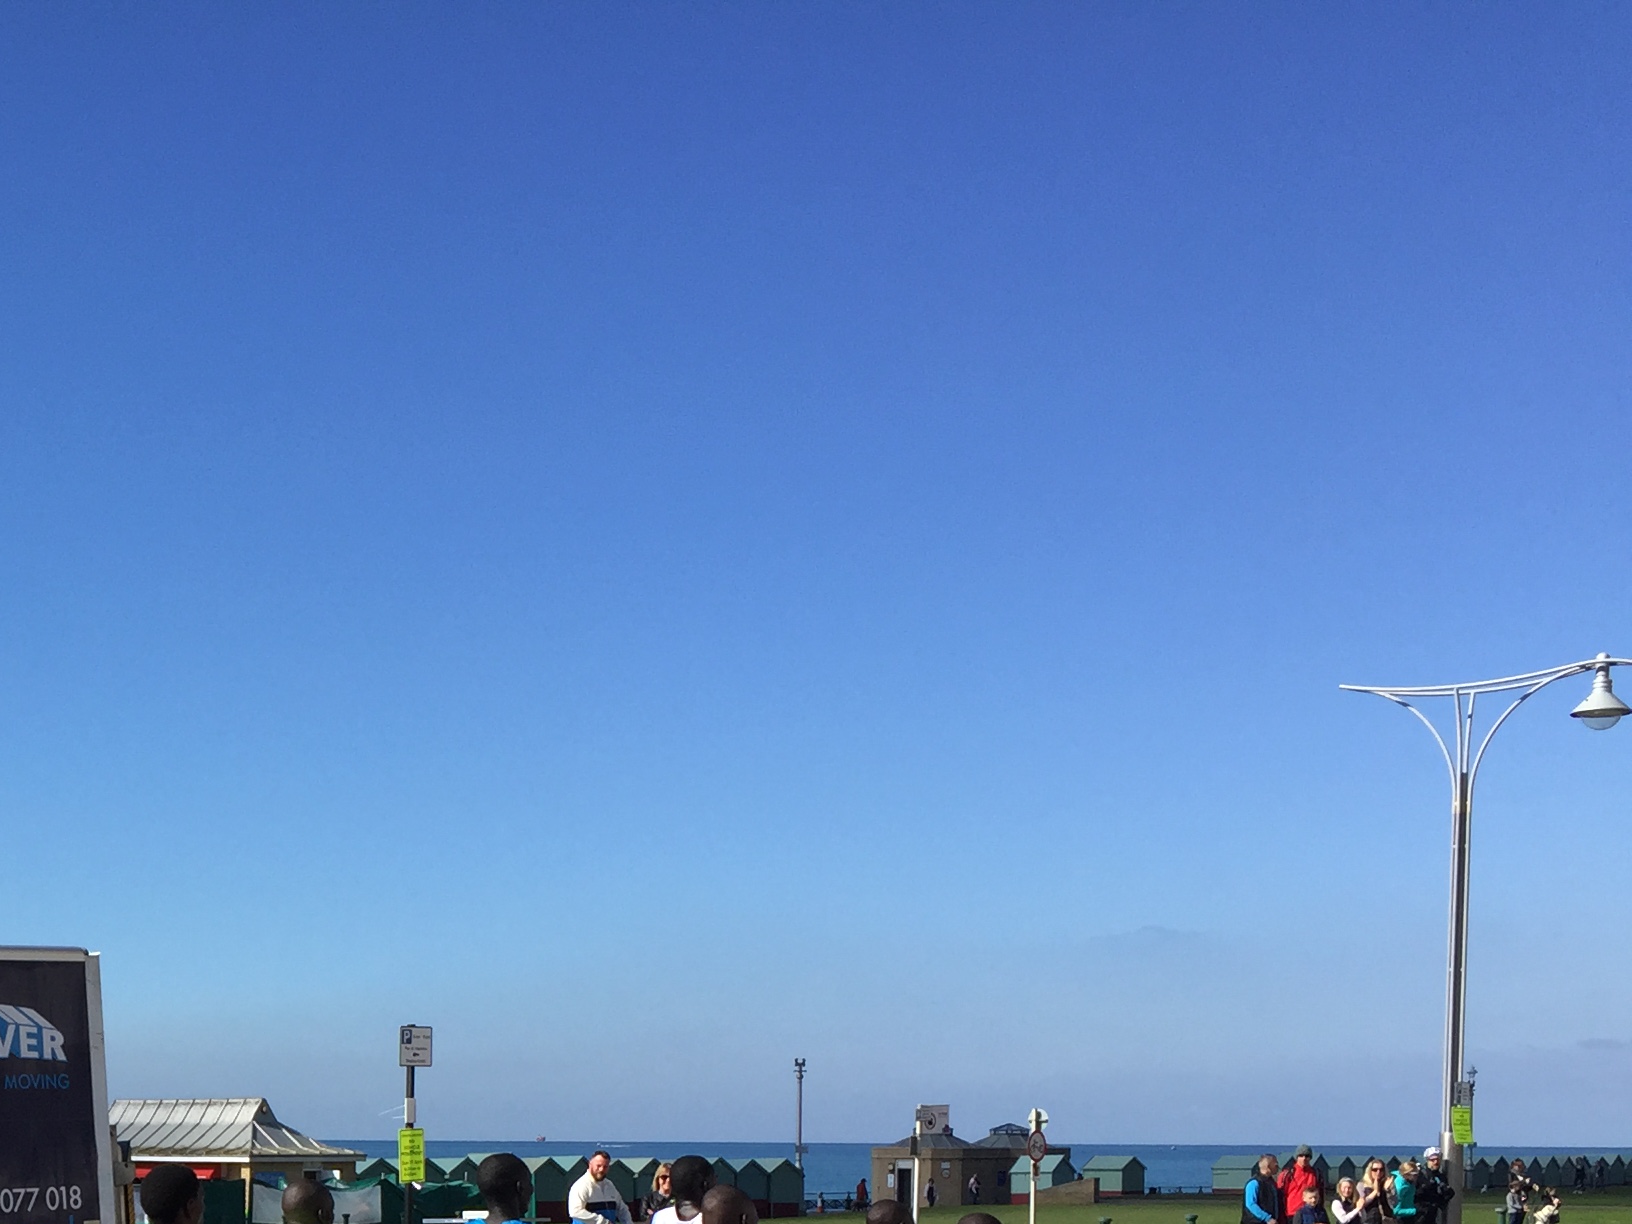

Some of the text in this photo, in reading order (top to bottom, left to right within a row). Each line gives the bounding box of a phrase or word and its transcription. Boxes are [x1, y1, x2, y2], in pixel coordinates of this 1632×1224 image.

[4, 1073, 70, 1090] MOVING
[0, 1187, 40, 1213] 077
[45, 1184, 82, 1211] 018
